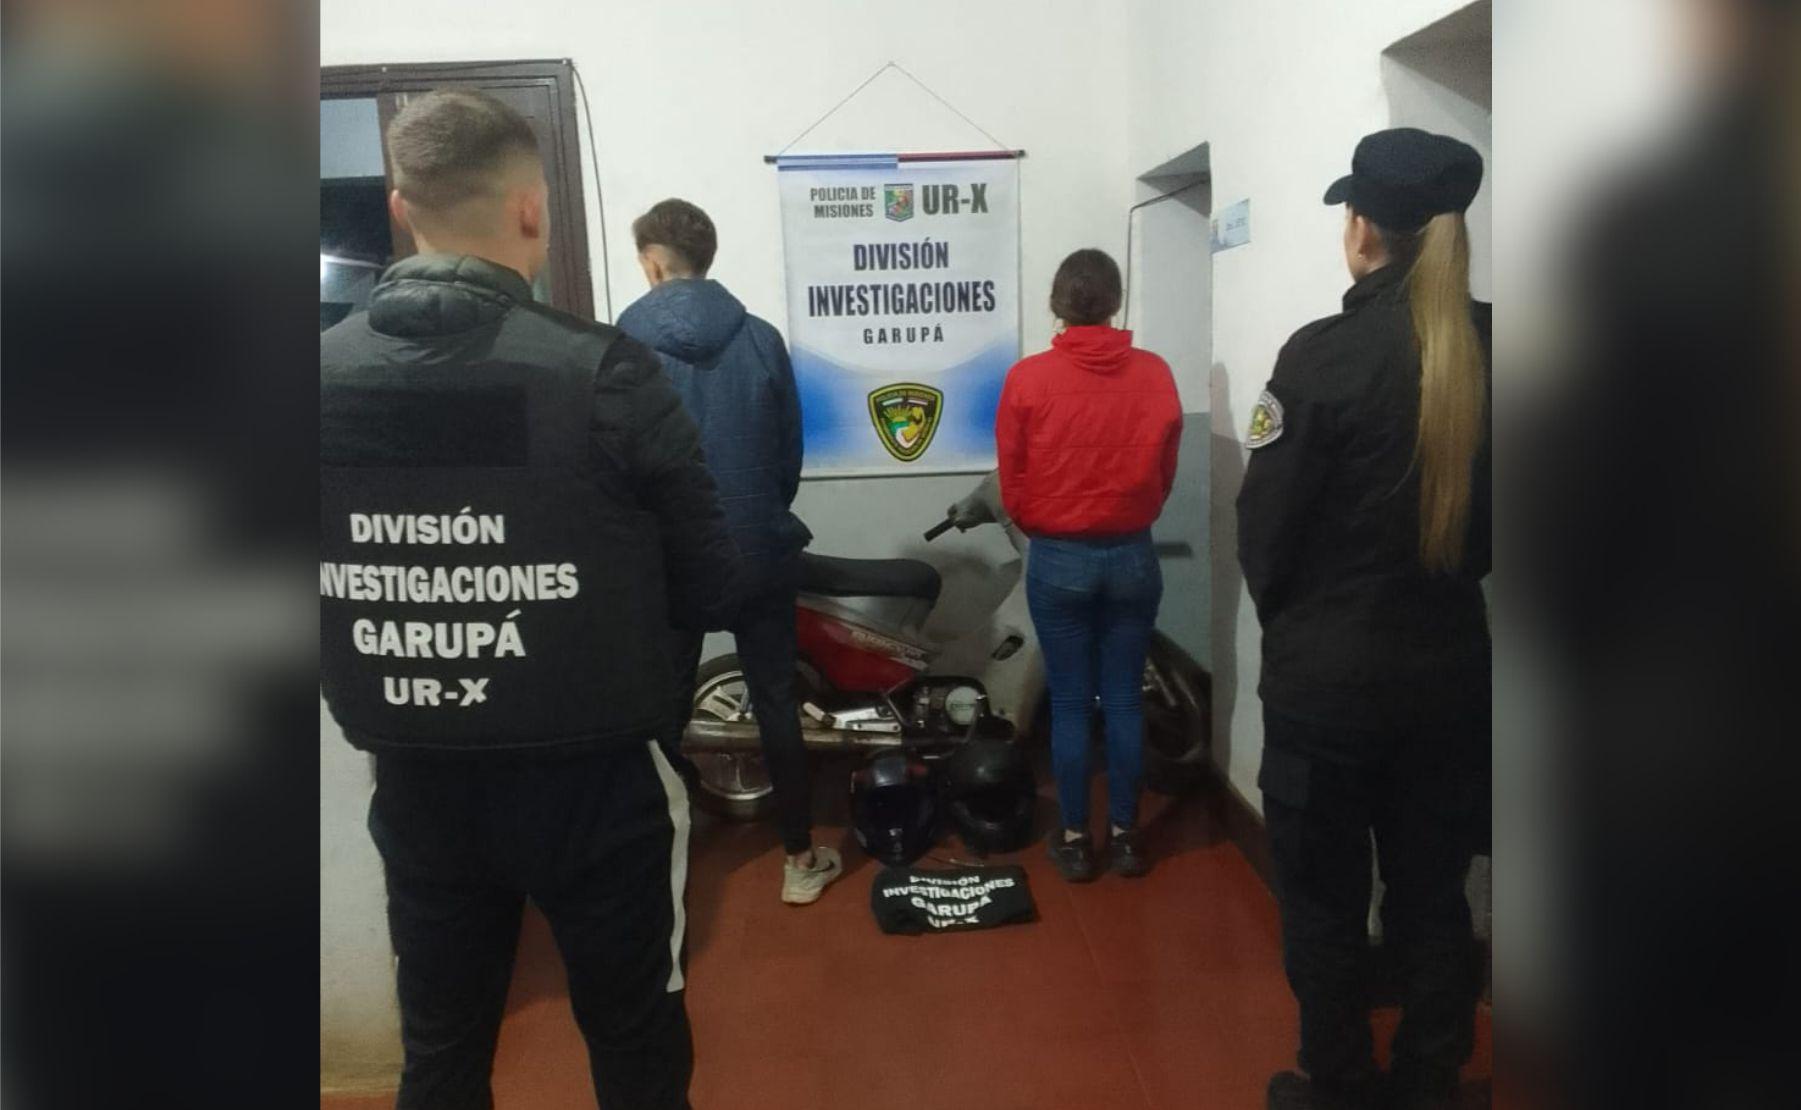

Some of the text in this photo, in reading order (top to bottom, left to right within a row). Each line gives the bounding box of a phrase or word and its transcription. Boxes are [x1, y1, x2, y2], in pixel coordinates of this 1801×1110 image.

[810, 186, 876, 201] POLICIA DE
[922, 183, 989, 215] UR-X
[814, 204, 874, 218] MISIONES
[853, 237, 949, 271] DIVISIÓN
[808, 280, 996, 317] INVESTIGACIONES
[863, 323, 944, 345] GARUPÁ
[350, 506, 505, 544] DIVISIÓN
[320, 562, 579, 602] NVESTIGACIONES
[353, 609, 526, 658] GARUPÁ
[384, 677, 490, 706] UR-X
